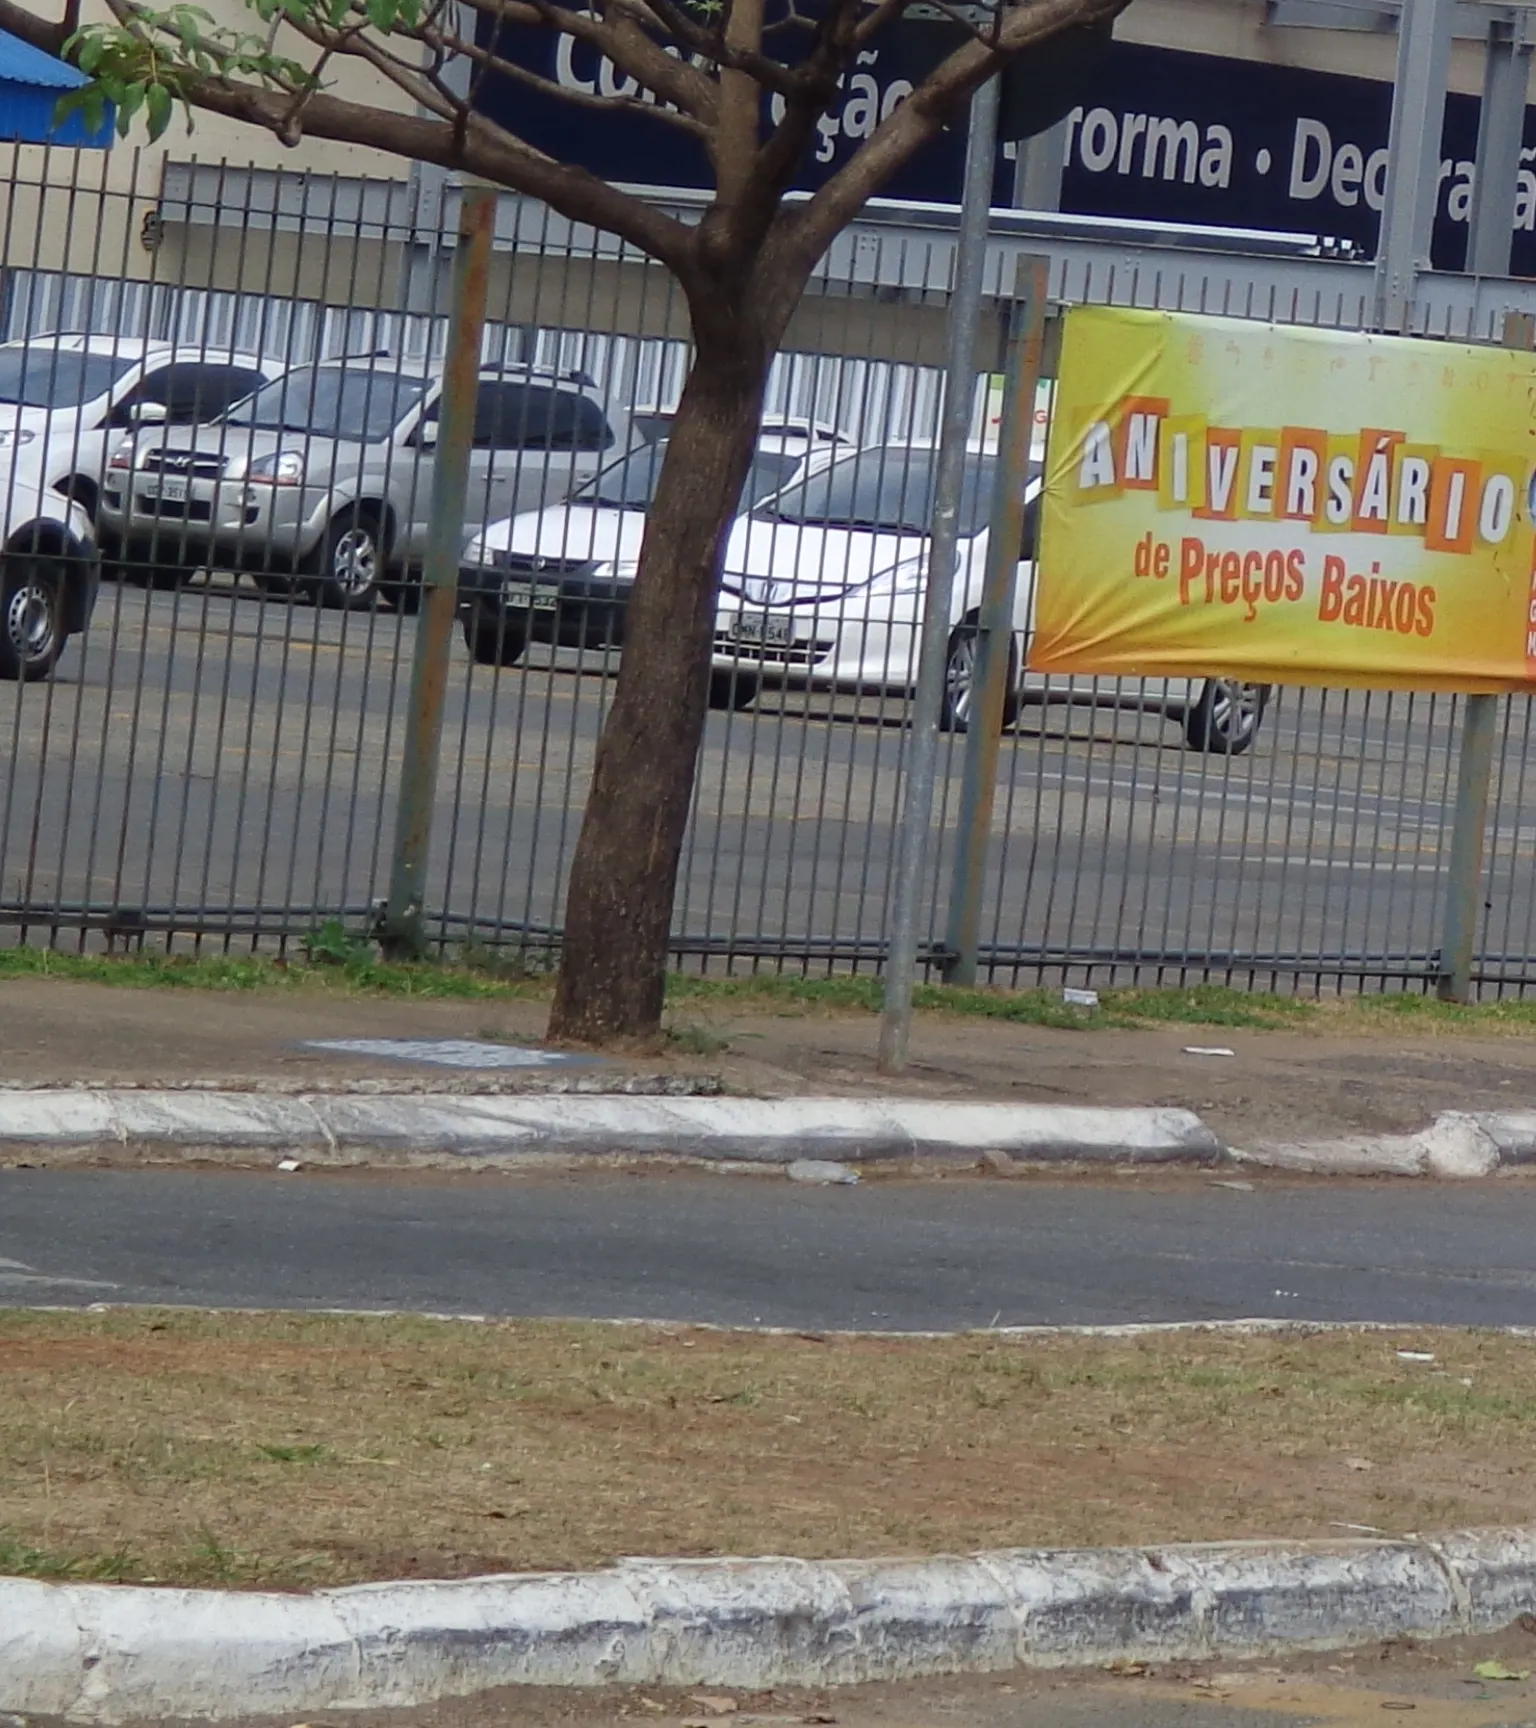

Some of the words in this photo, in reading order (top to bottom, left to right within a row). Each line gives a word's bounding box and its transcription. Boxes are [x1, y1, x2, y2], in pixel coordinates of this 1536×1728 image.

[1078, 410, 1515, 545] ANIVERSÁRIO
[1134, 531, 1170, 581] de
[1179, 537, 1306, 622] Preços
[1318, 554, 1436, 638] Baixos
